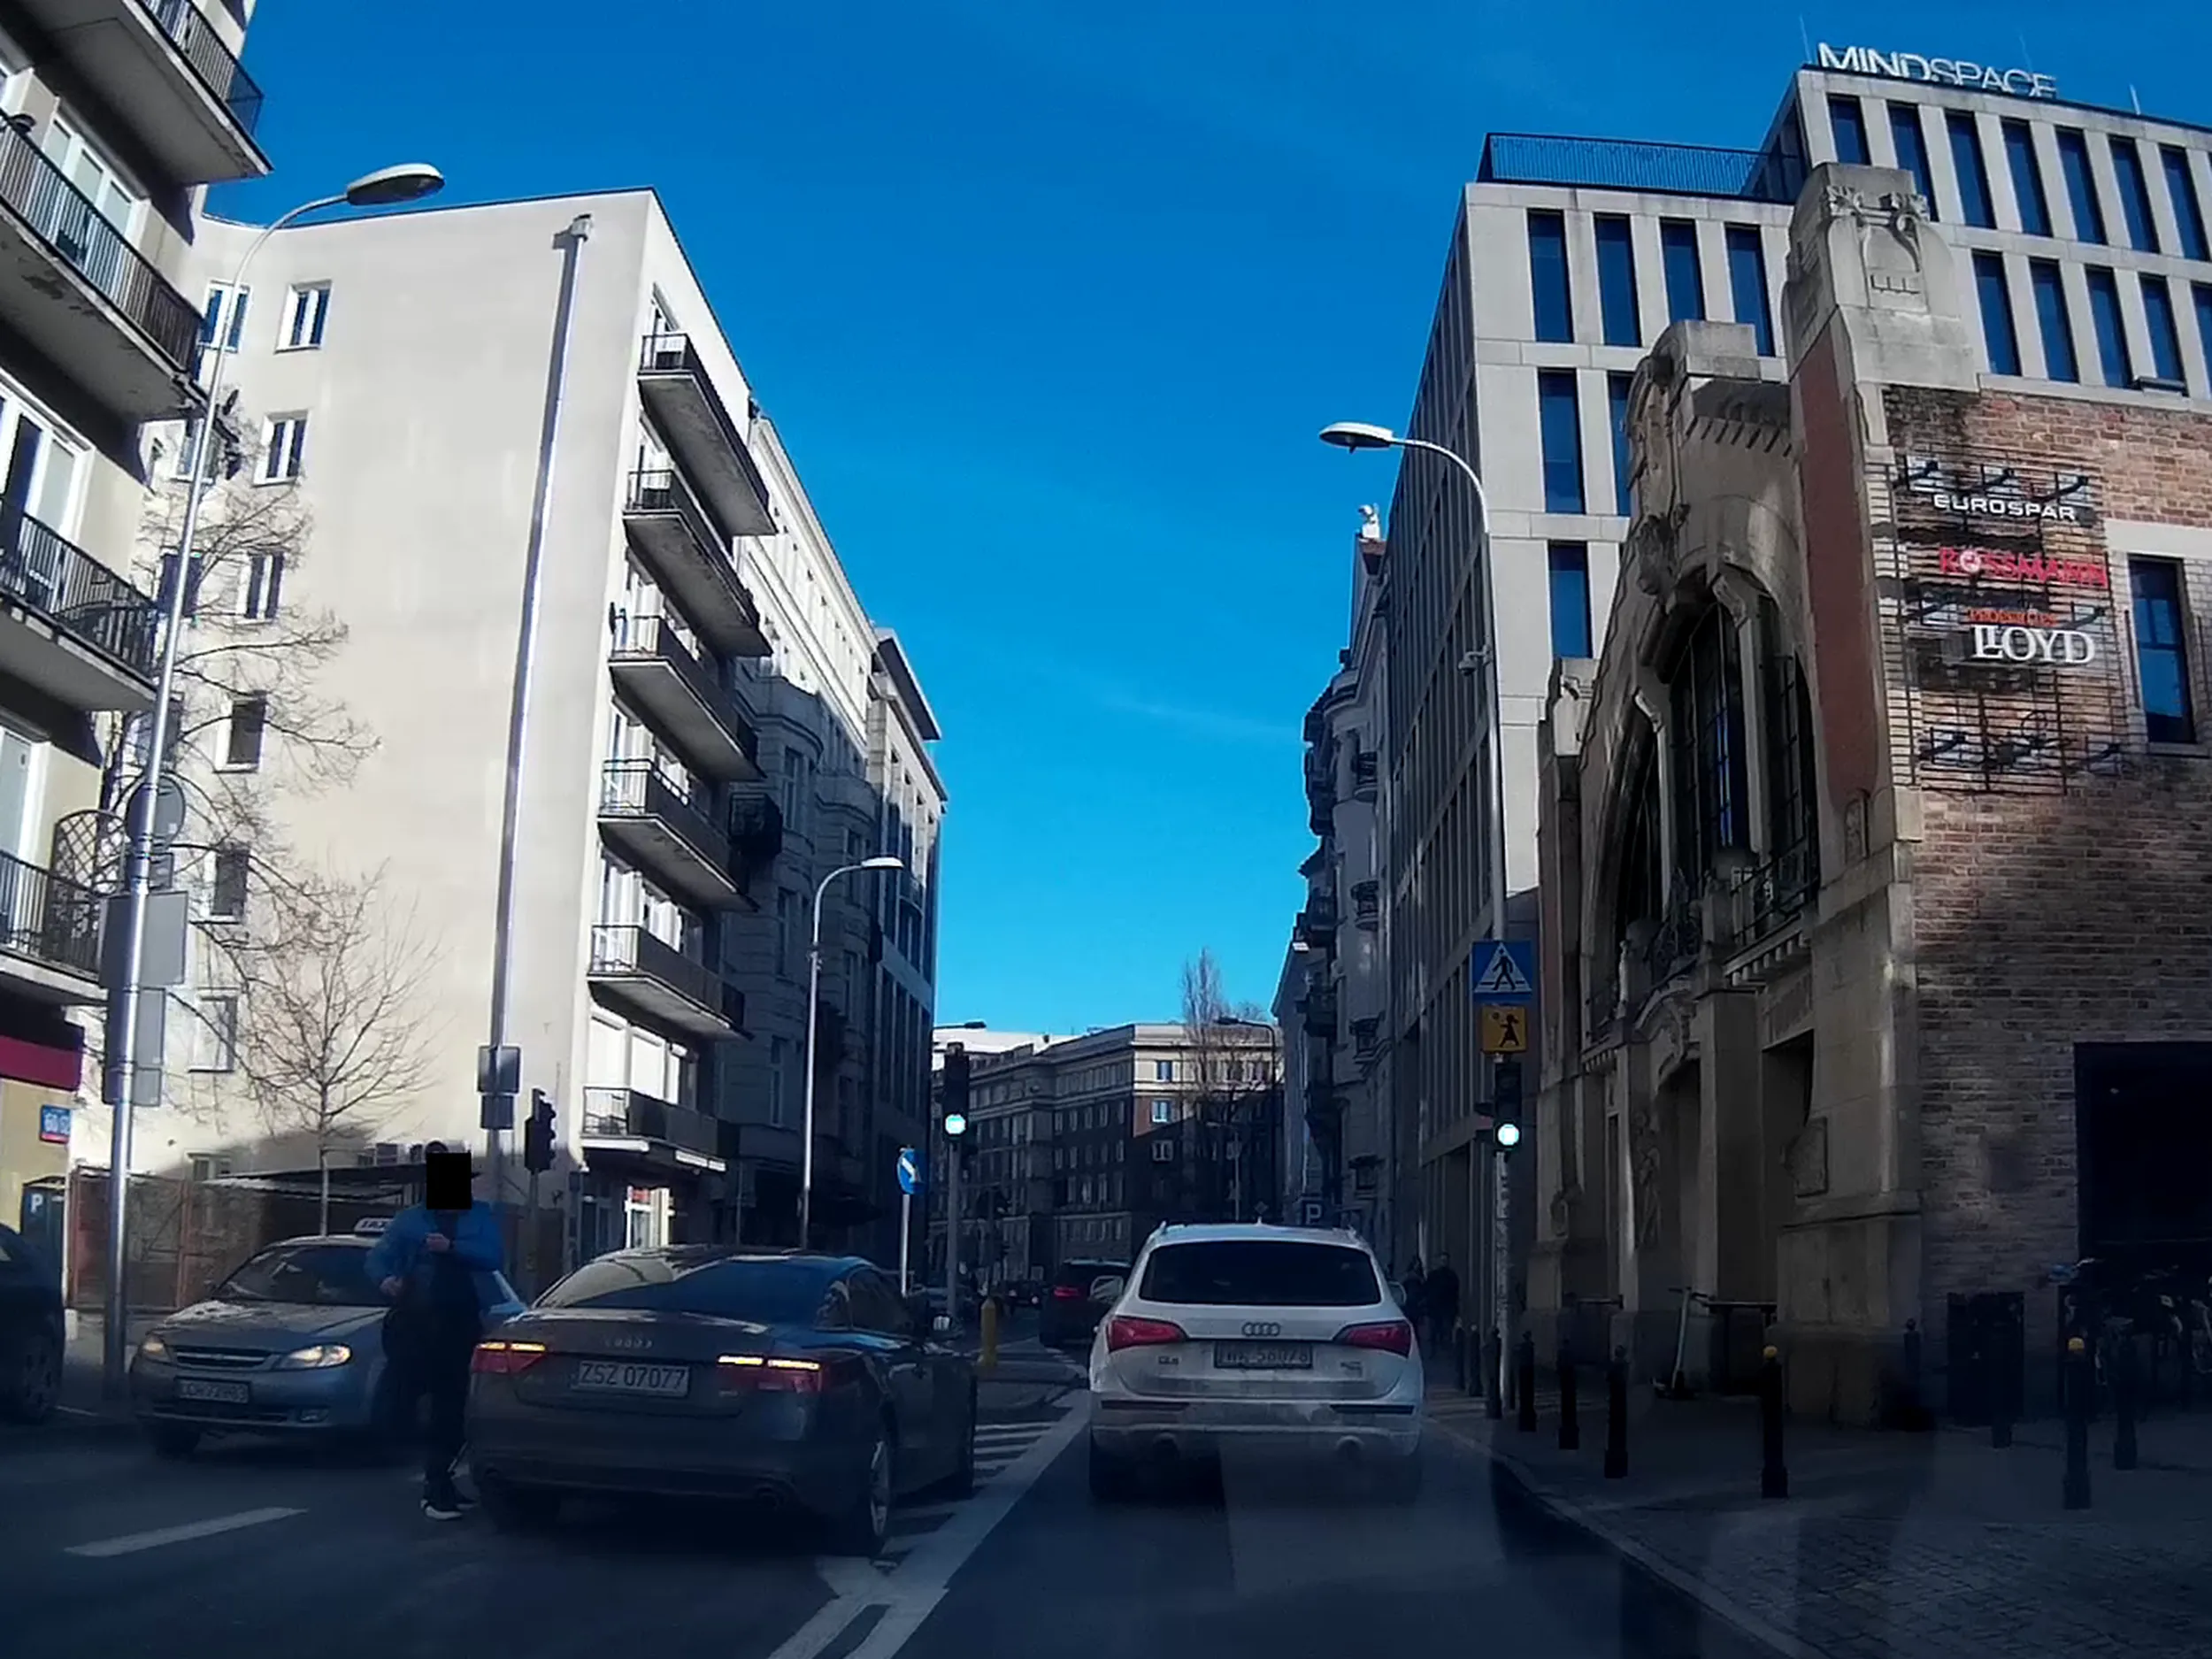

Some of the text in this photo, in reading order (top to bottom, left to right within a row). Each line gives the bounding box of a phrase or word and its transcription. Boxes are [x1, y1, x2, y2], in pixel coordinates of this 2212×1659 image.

[1818, 42, 2056, 96] MINDSPACE
[1933, 494, 2077, 521] EUROSPAR
[1973, 624, 2095, 665] LLOYD
[31, 1193, 43, 1213] P
[1306, 1203, 1322, 1225] P
[580, 1363, 687, 1389] ZSZ 07077
